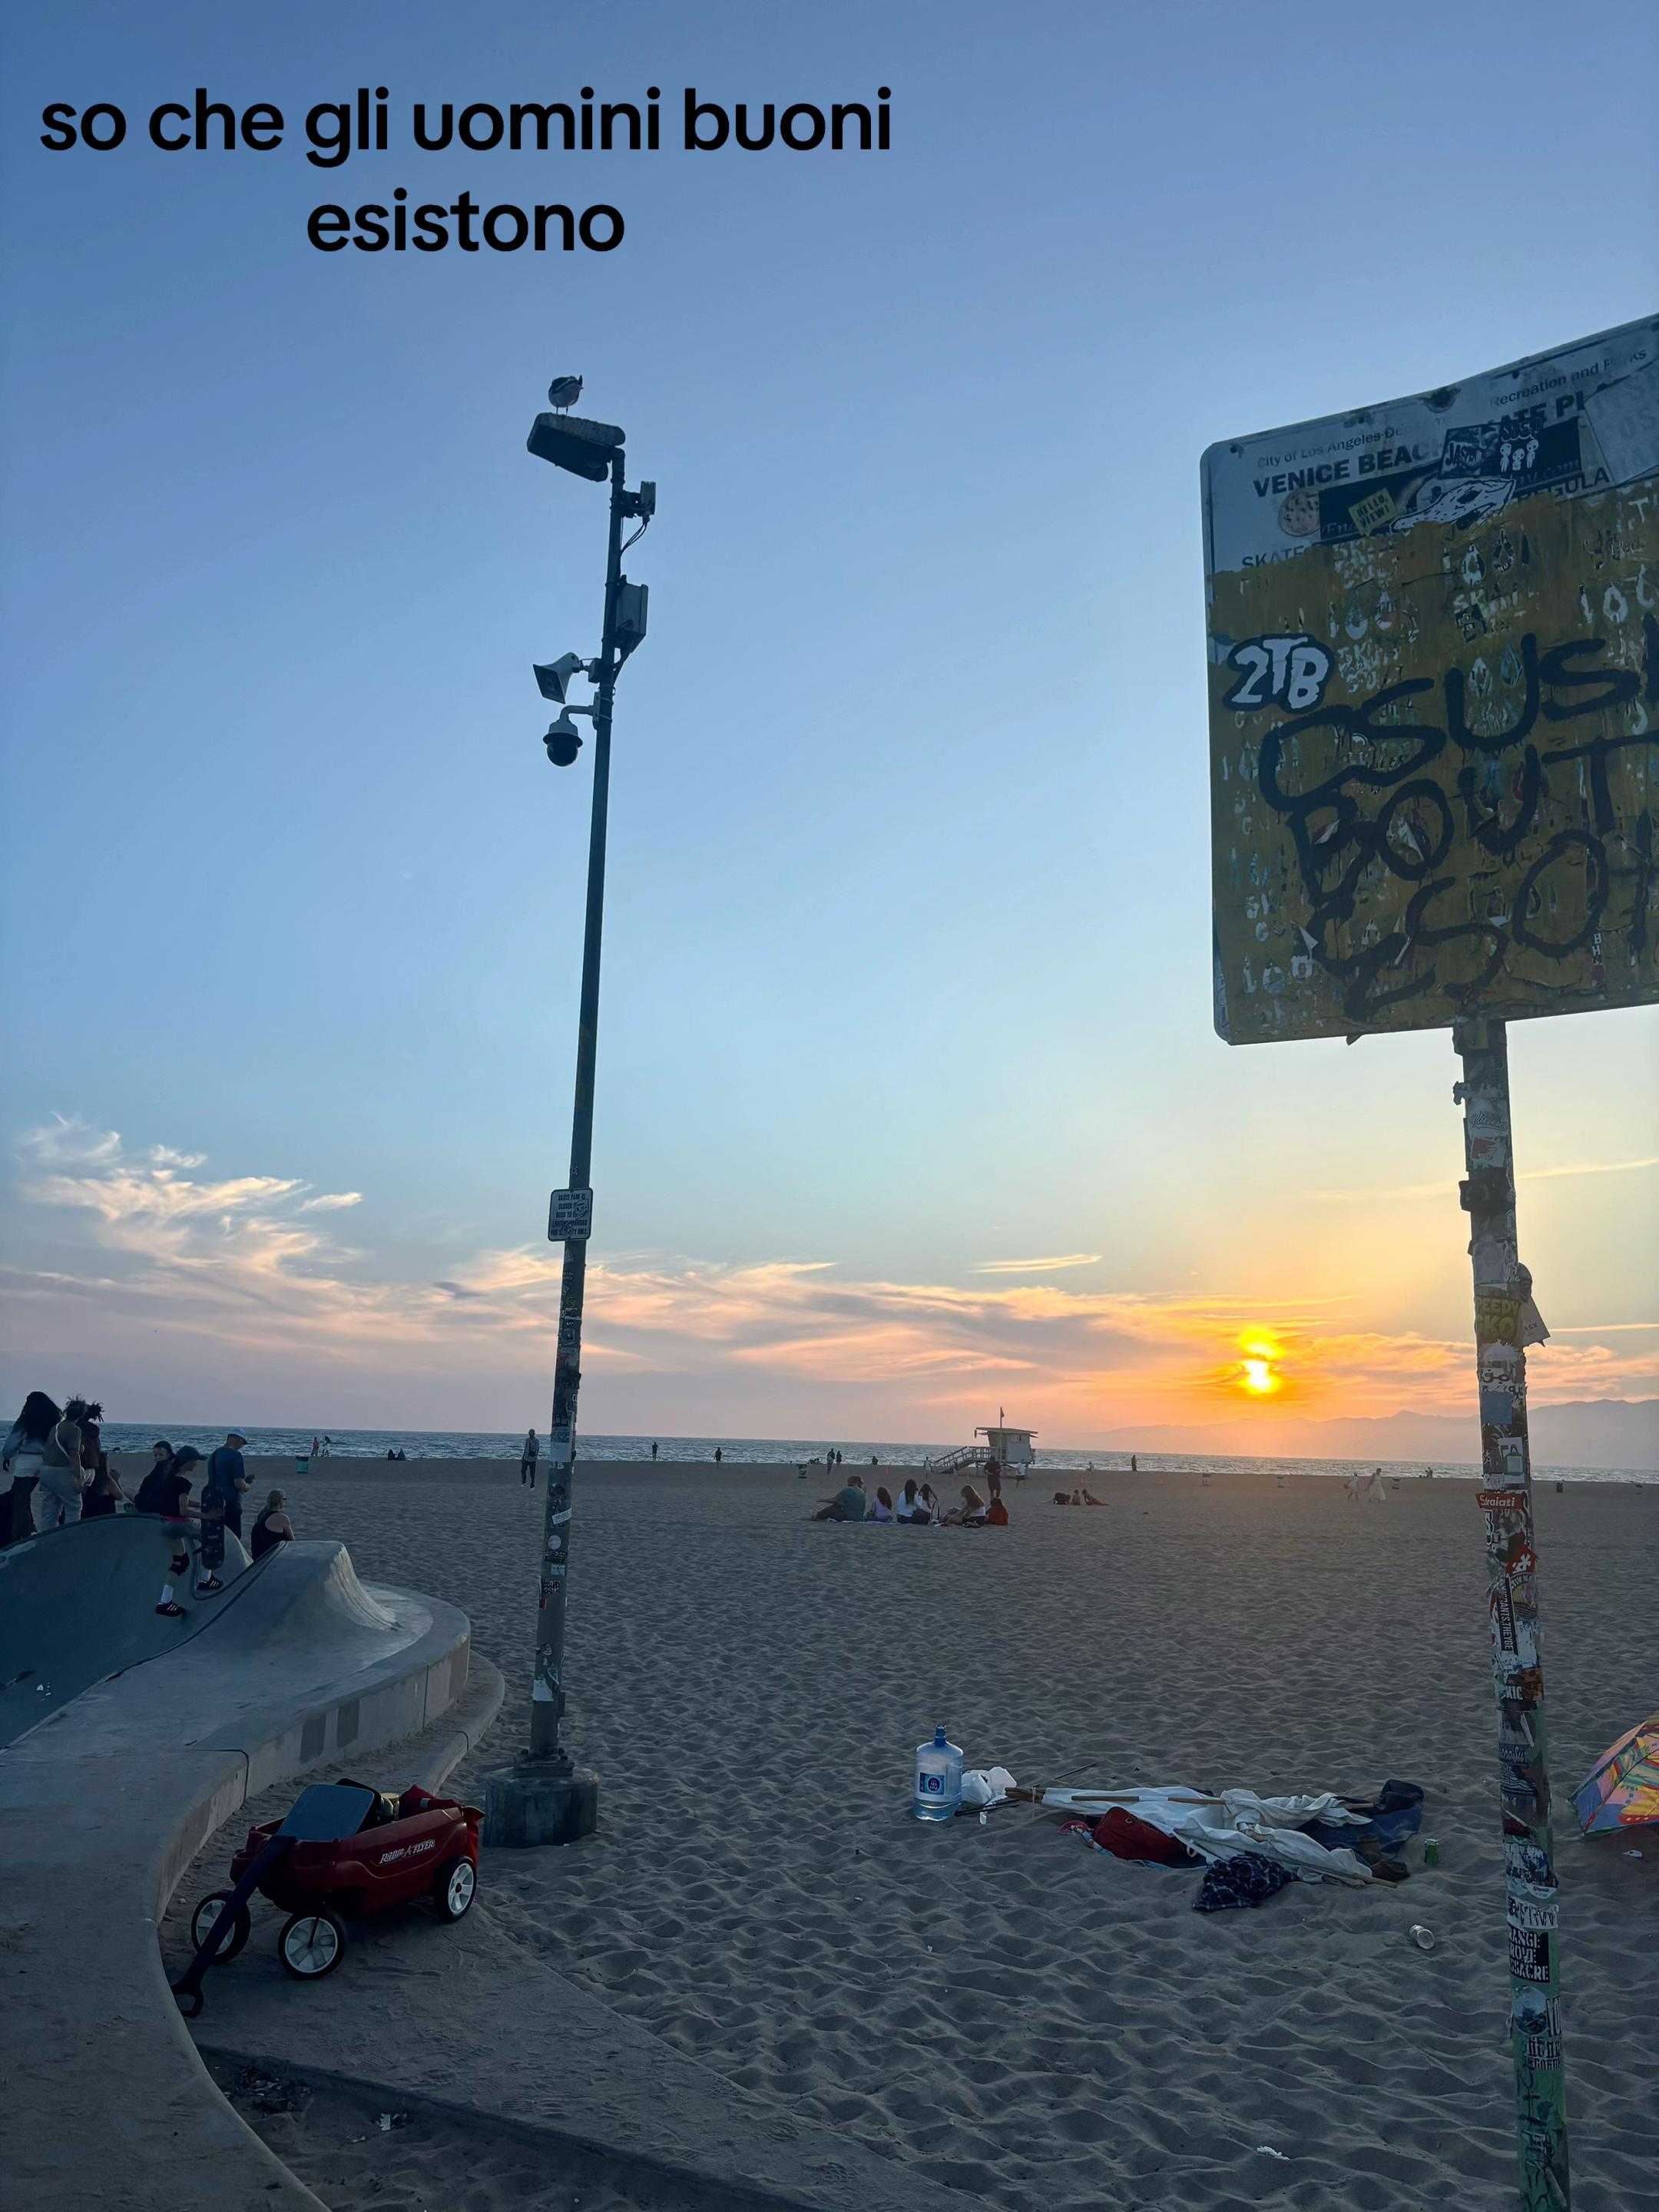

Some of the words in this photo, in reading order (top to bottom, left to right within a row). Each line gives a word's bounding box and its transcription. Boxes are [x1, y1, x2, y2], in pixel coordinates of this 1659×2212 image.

[1257, 456, 1281, 468] City
[1284, 451, 1297, 462] of
[1301, 446, 1323, 459] Los
[1327, 430, 1380, 452] Angeles
[1491, 376, 1567, 406] Recreation
[1571, 362, 1599, 384] and
[1253, 459, 1350, 498] VENICE
[1230, 636, 1330, 710] 2TB
[412, 1839, 435, 1854] FLYER
